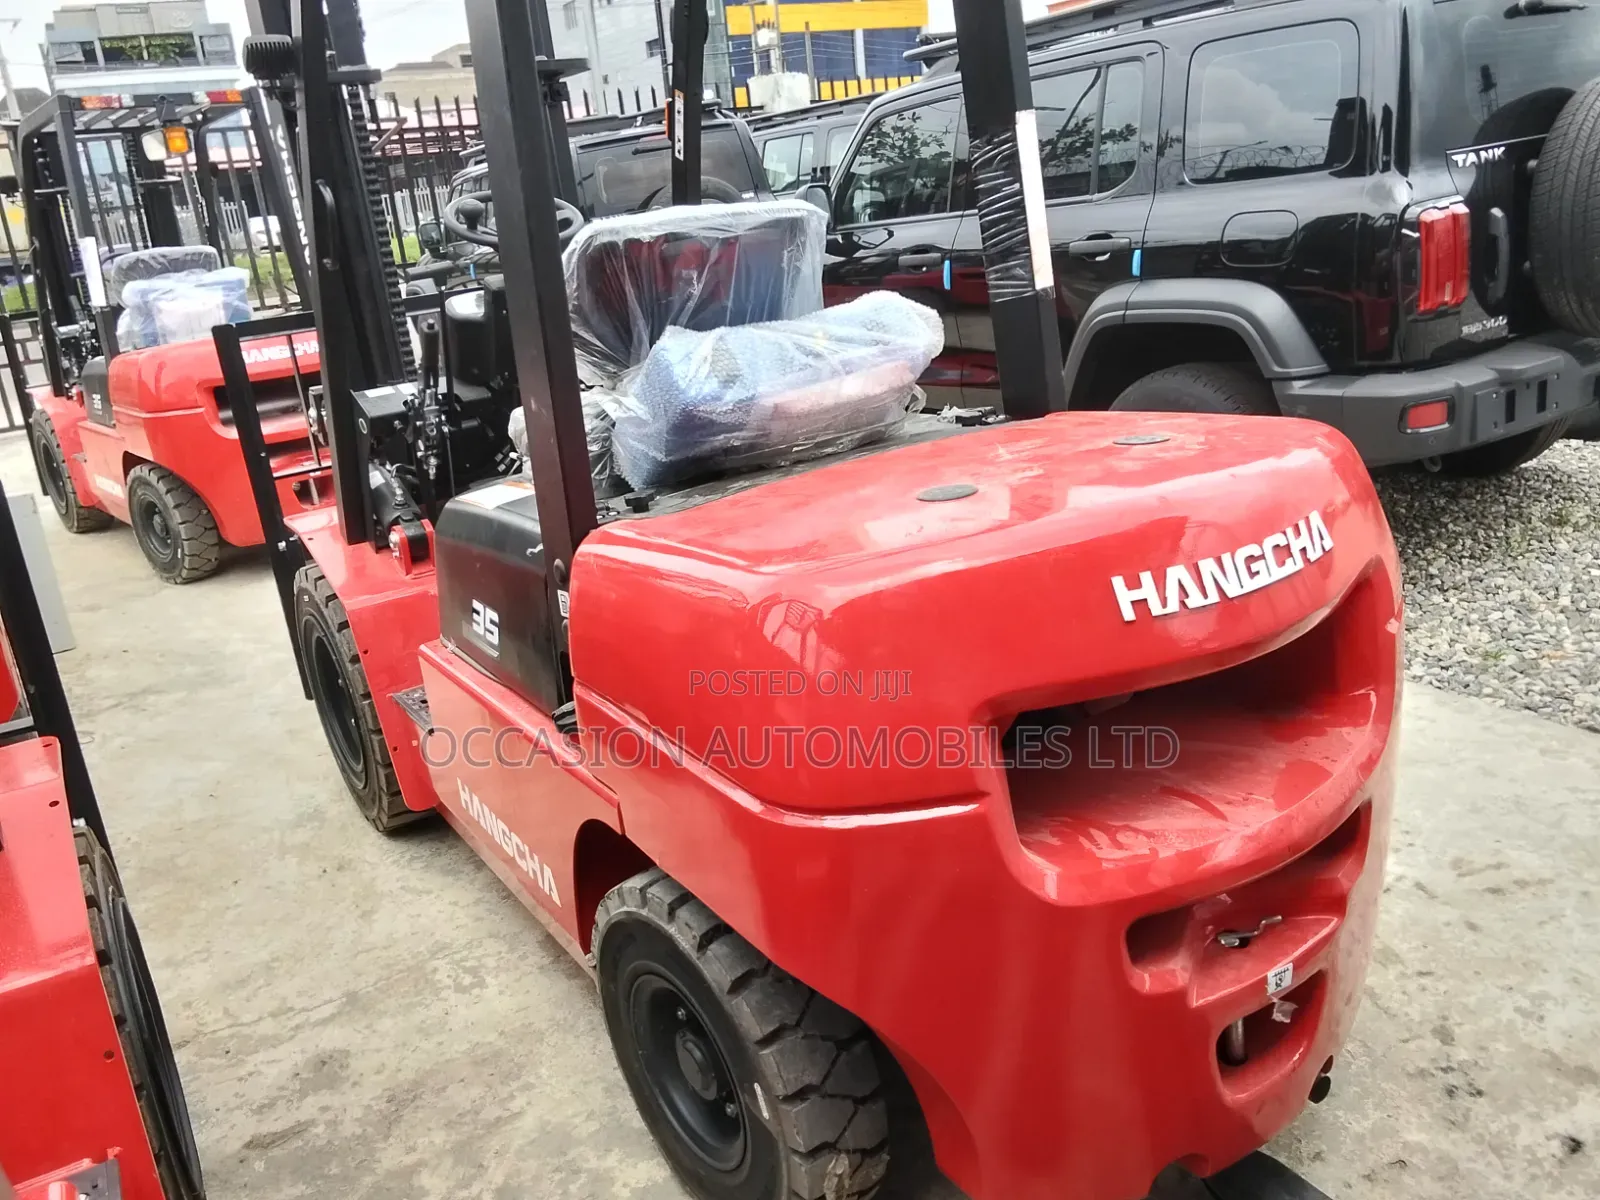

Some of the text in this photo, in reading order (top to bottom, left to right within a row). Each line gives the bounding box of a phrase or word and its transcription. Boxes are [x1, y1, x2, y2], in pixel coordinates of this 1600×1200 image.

[276, 124, 312, 277] ANGCHA
[1451, 146, 1505, 168] TANK
[472, 598, 499, 646] 35
[1110, 509, 1334, 622] HANGCHA
[456, 776, 562, 908] HANGCHA
